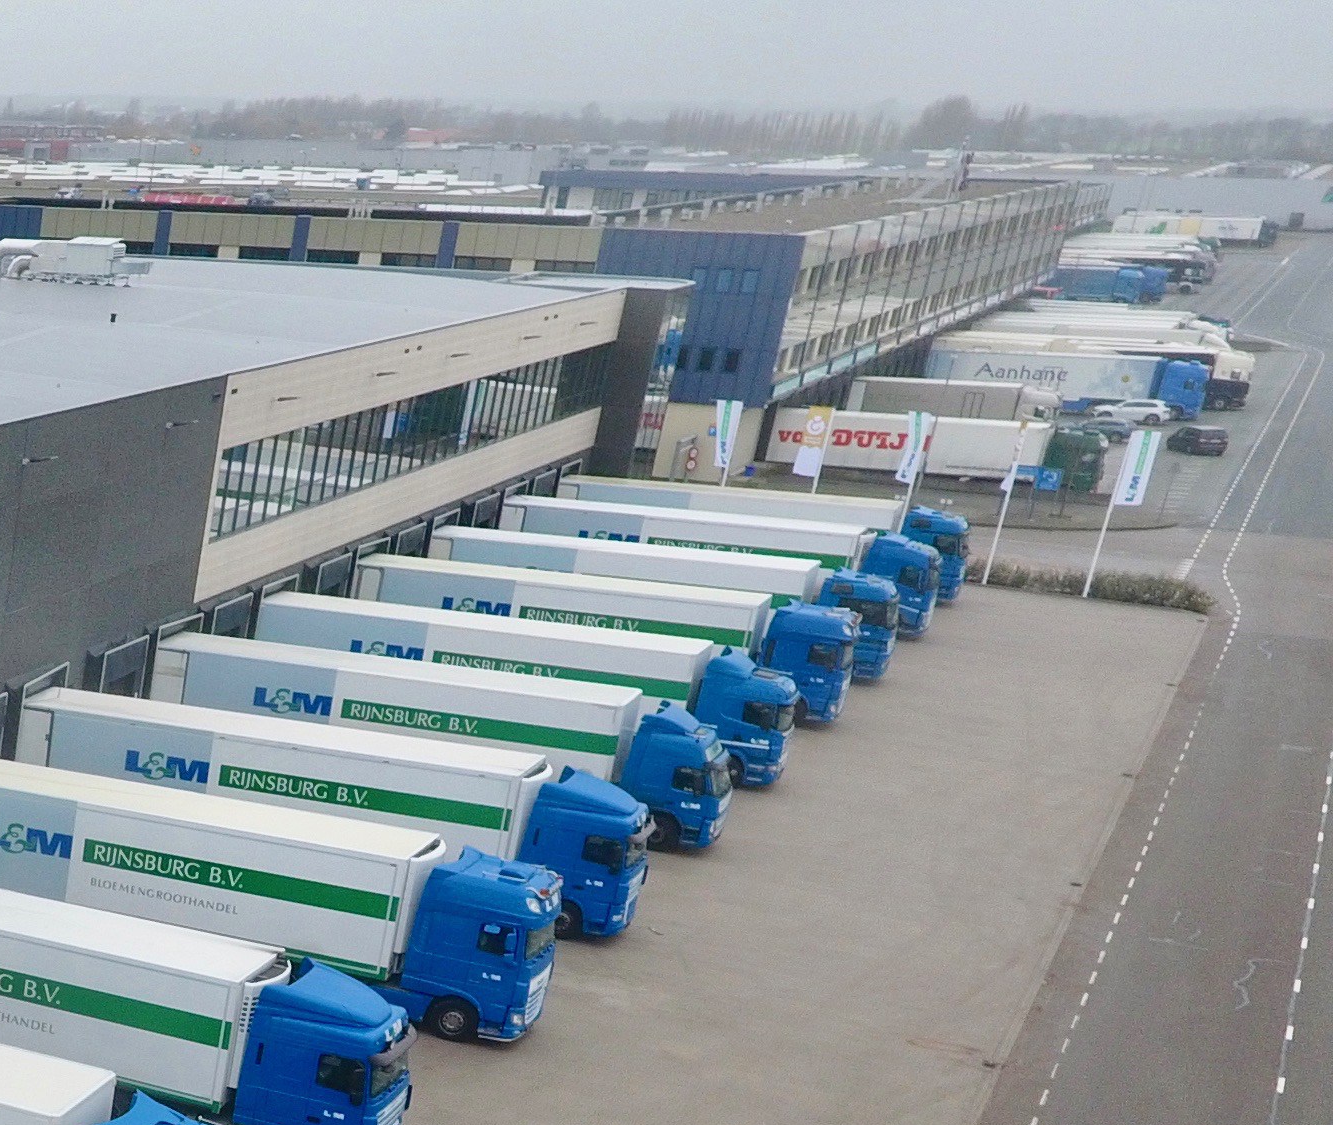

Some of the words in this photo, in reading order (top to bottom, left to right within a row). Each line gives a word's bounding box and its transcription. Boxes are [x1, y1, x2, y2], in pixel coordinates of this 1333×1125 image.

[831, 428, 932, 453] DUIJ
[253, 687, 333, 716] L&M
[349, 703, 442, 730] RIJNSBURG
[447, 717, 479, 735] B.V.
[124, 749, 210, 784] L&M
[228, 769, 330, 799] RIJNSBURG
[335, 787, 369, 806] B.V.
[93, 844, 201, 881] RIJNSBURG
[208, 866, 244, 889] B.V.
[90, 877, 239, 915] BLOEMENGROOTHANDEL
[22, 979, 61, 1005] B.V.
